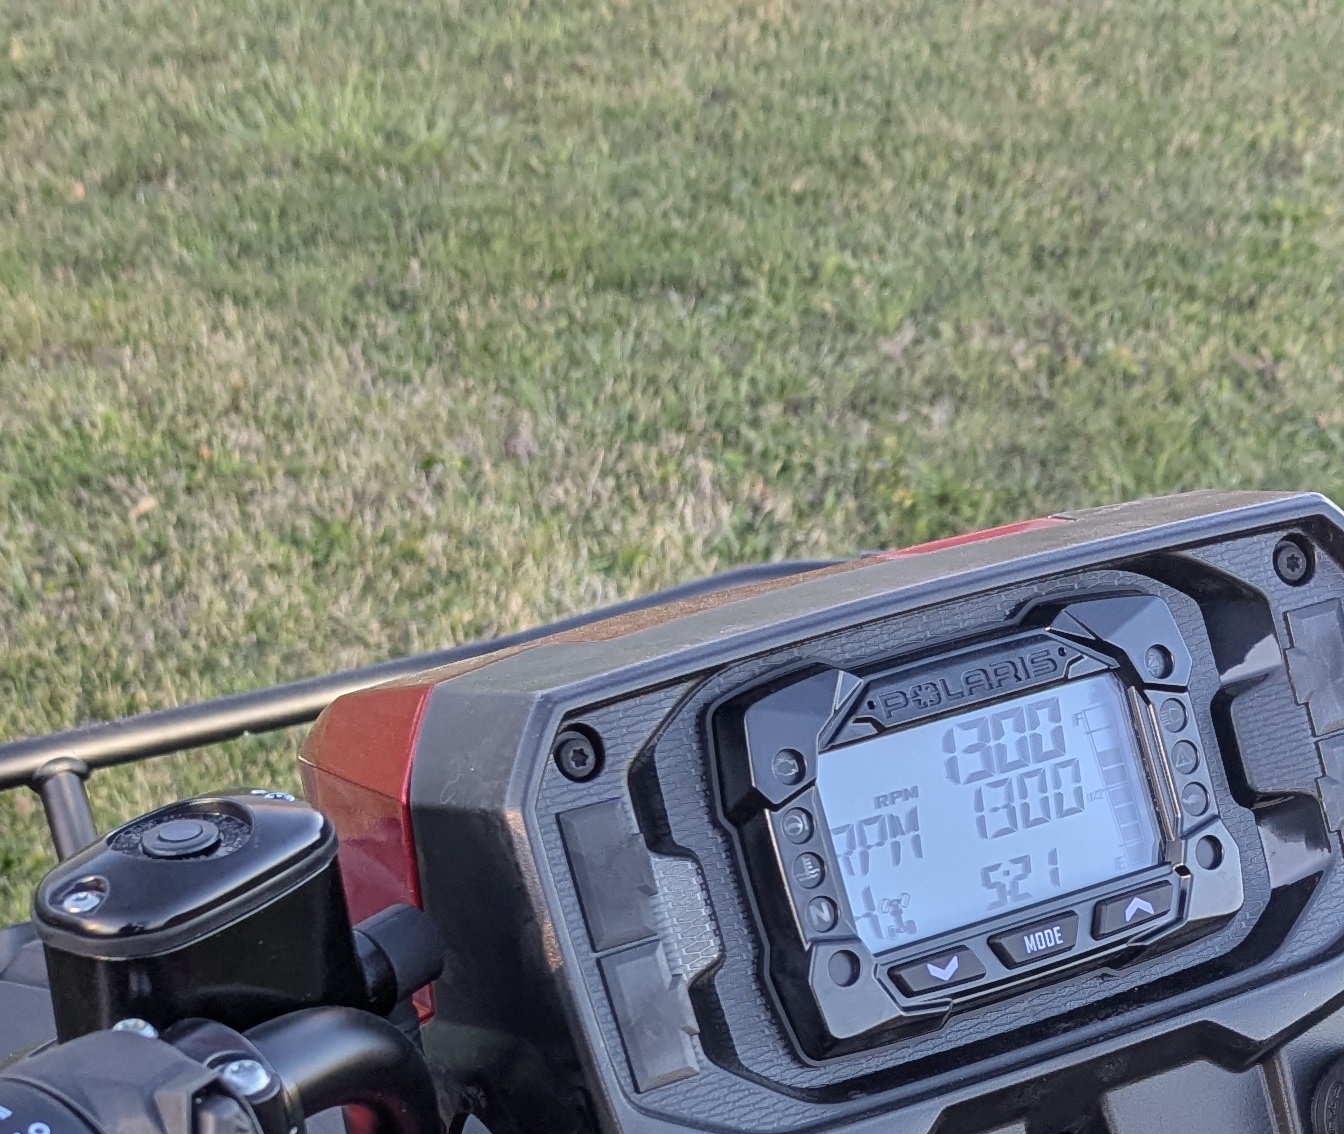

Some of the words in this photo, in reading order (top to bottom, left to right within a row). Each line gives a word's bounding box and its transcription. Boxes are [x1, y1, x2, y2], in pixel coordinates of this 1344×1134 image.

[878, 648, 1058, 720] POLARIS
[942, 696, 1066, 785] 1300
[873, 785, 919, 809] RPM
[974, 757, 1085, 840] 1300
[811, 904, 832, 927] N
[1023, 927, 1064, 954] MODE
